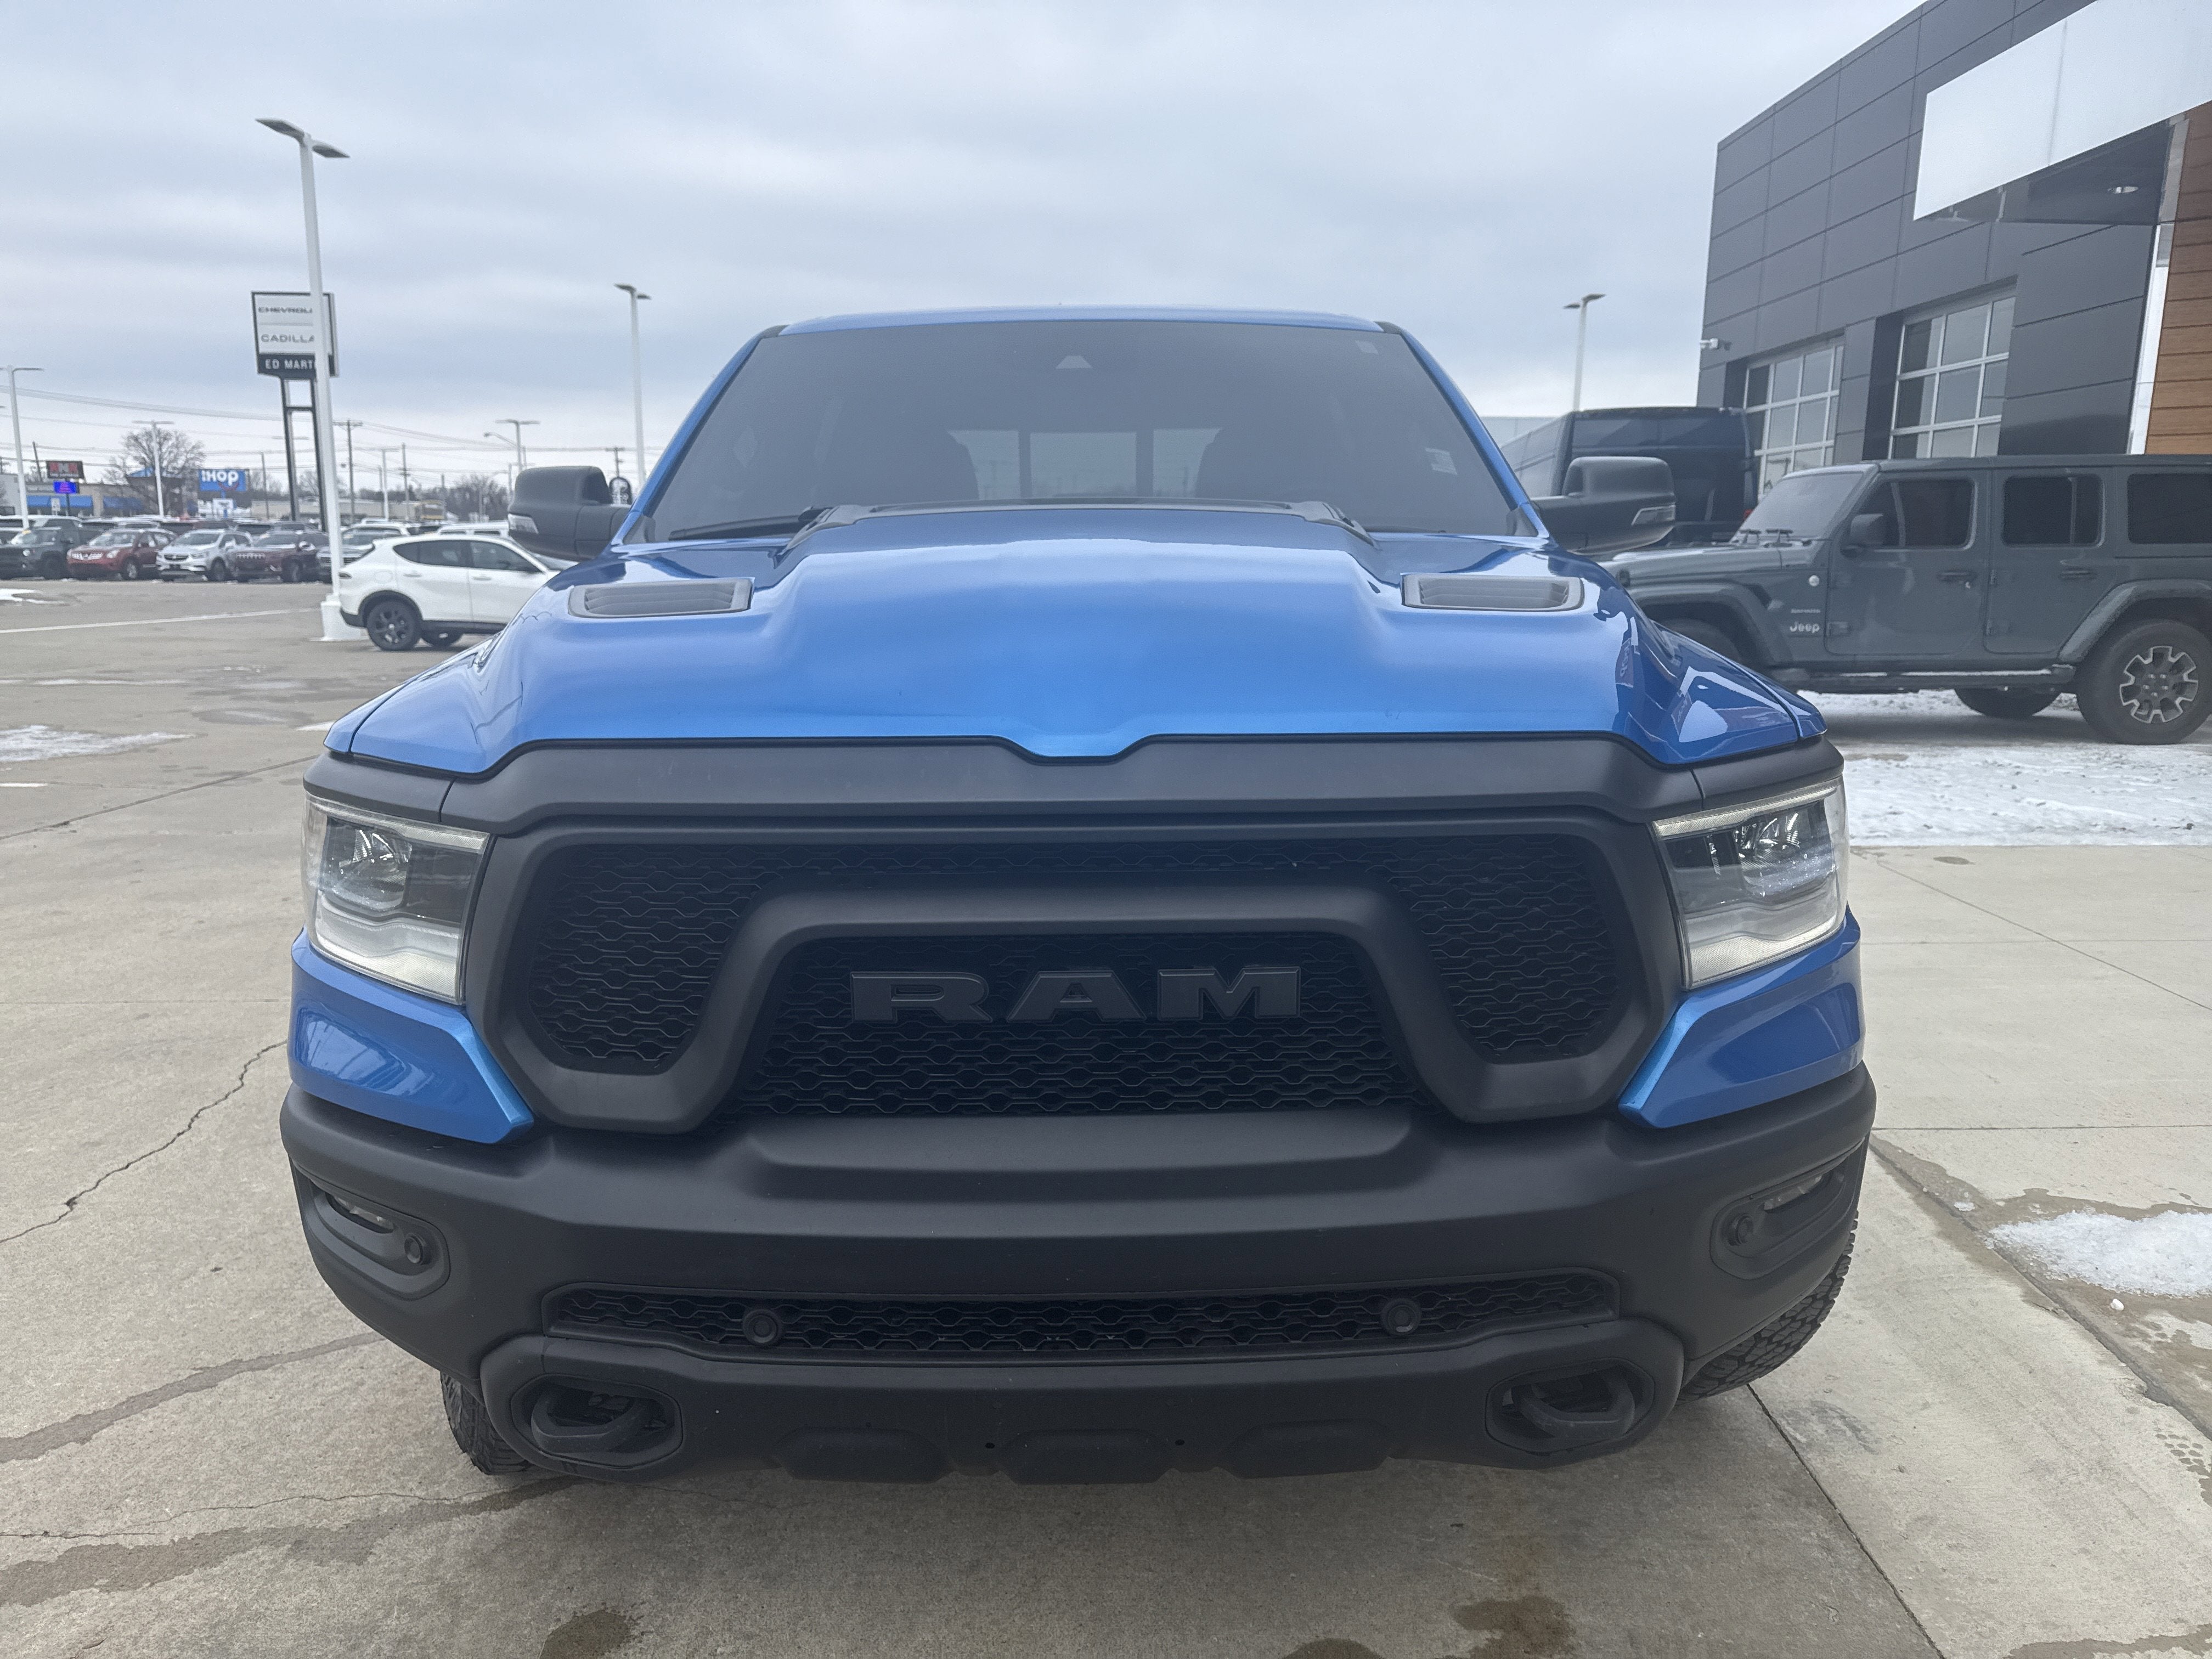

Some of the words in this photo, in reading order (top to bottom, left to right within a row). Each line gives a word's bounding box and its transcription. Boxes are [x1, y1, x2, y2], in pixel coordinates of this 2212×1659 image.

[261, 334, 315, 343] CADILLA
[265, 359, 279, 369] ED
[284, 359, 315, 370] MART
[1789, 621, 1820, 634] Jeep
[850, 966, 1301, 1023] RAM
